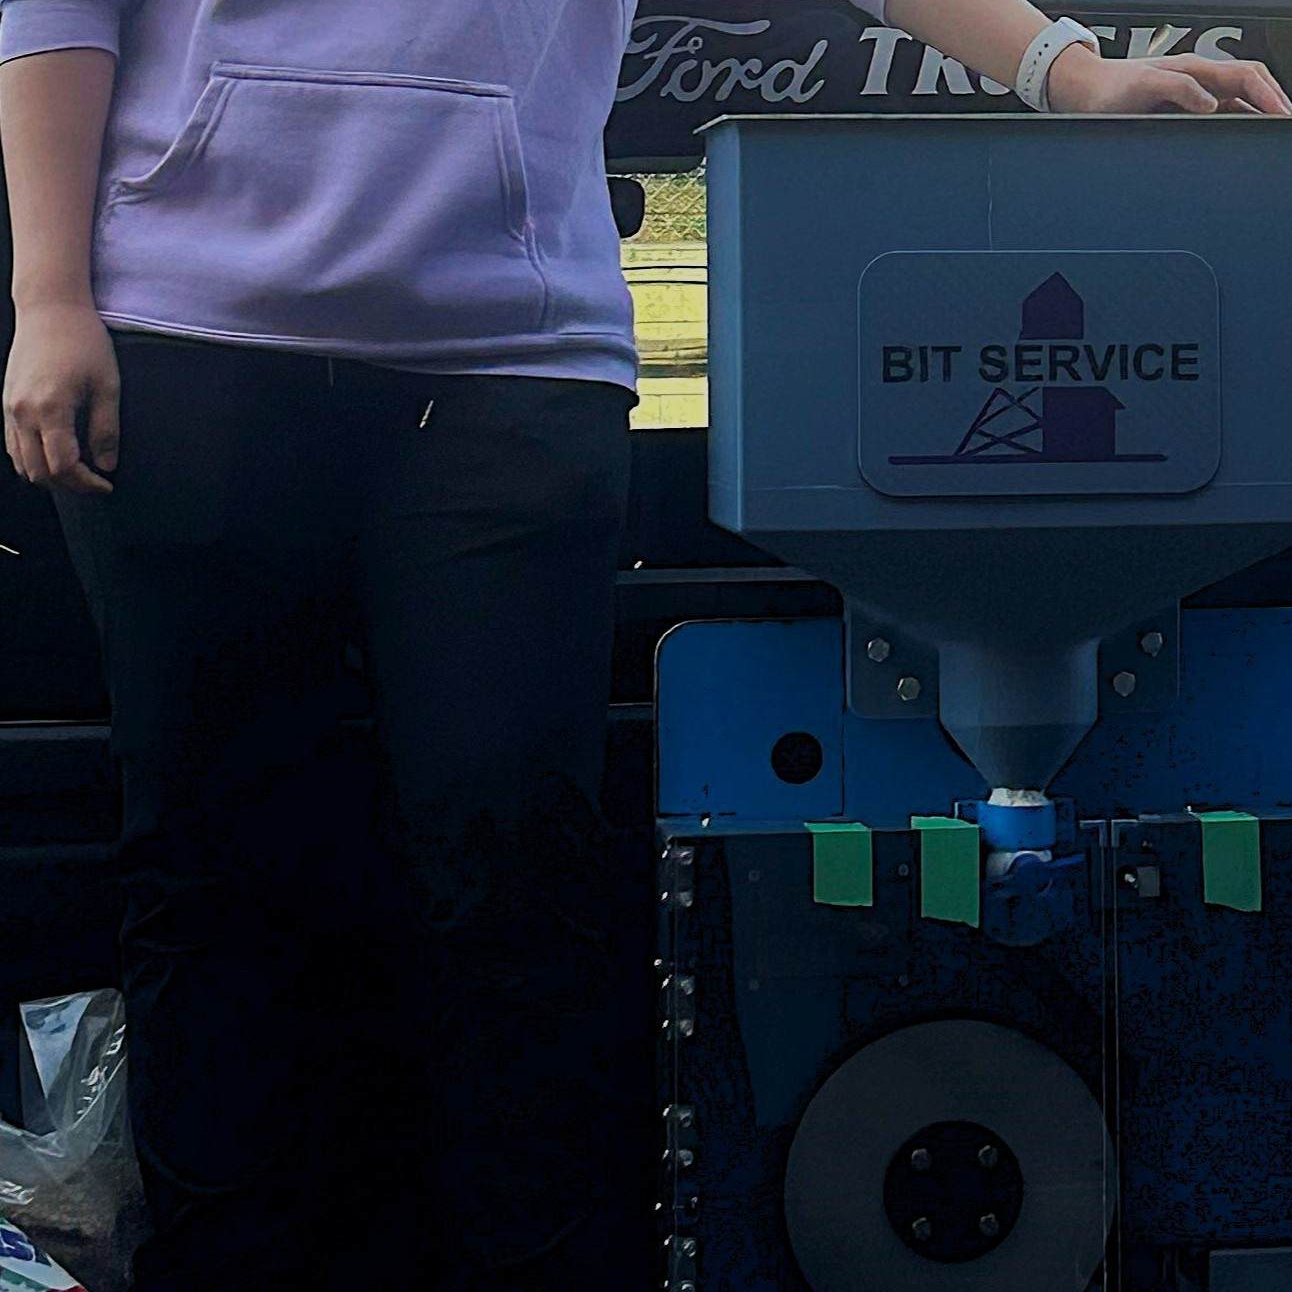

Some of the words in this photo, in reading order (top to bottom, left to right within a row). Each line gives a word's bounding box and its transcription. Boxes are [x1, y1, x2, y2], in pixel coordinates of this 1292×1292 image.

[616, 15, 828, 103] Ford
[882, 345, 962, 383] BIT
[978, 343, 1200, 383] SERVICE
